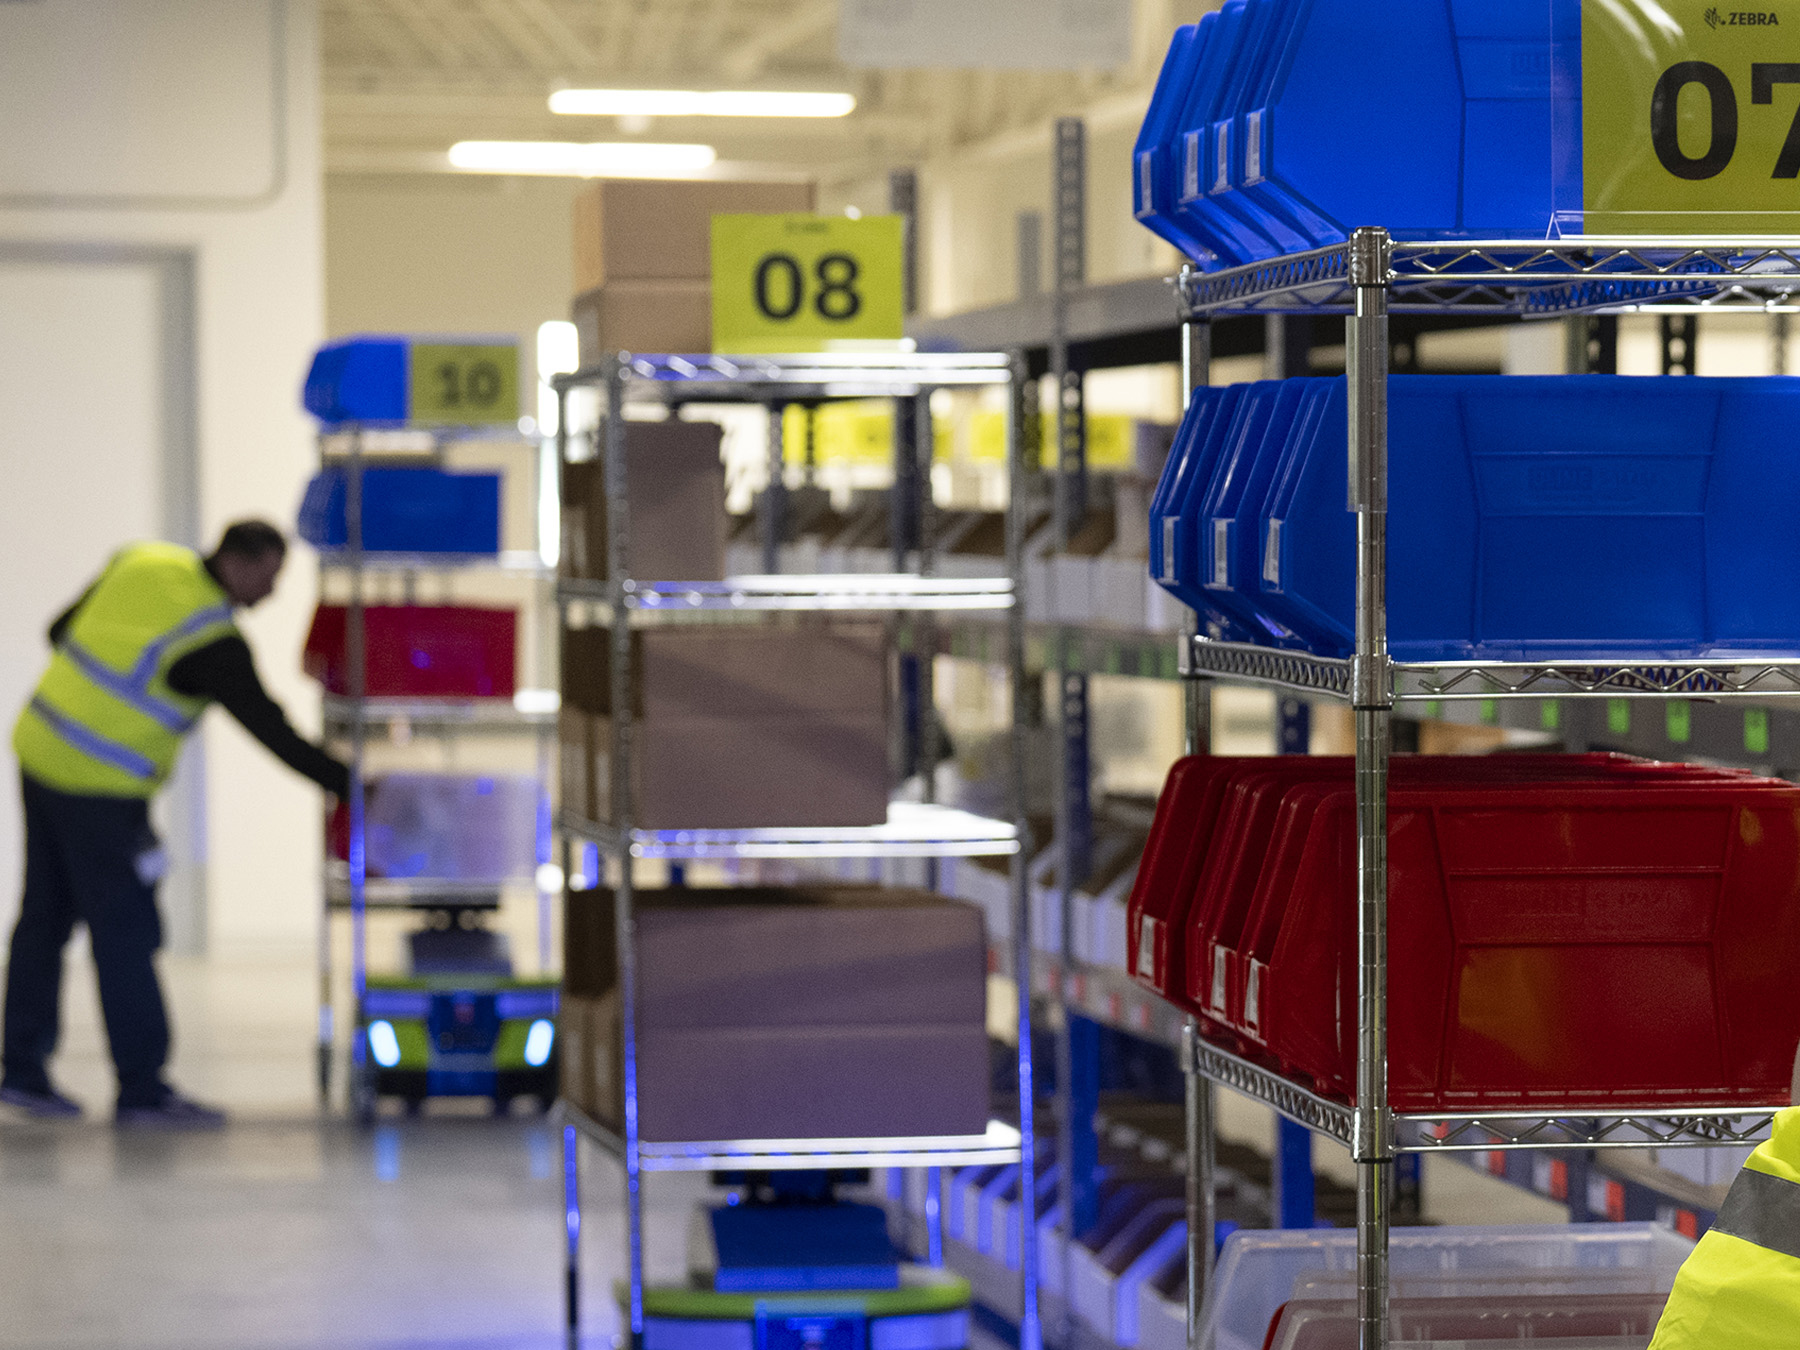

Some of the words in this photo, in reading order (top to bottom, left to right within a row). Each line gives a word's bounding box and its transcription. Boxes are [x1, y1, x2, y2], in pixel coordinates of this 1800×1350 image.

[1728, 12, 1779, 26] ZEBRA
[753, 250, 863, 322] 08
[433, 360, 504, 407] 10
